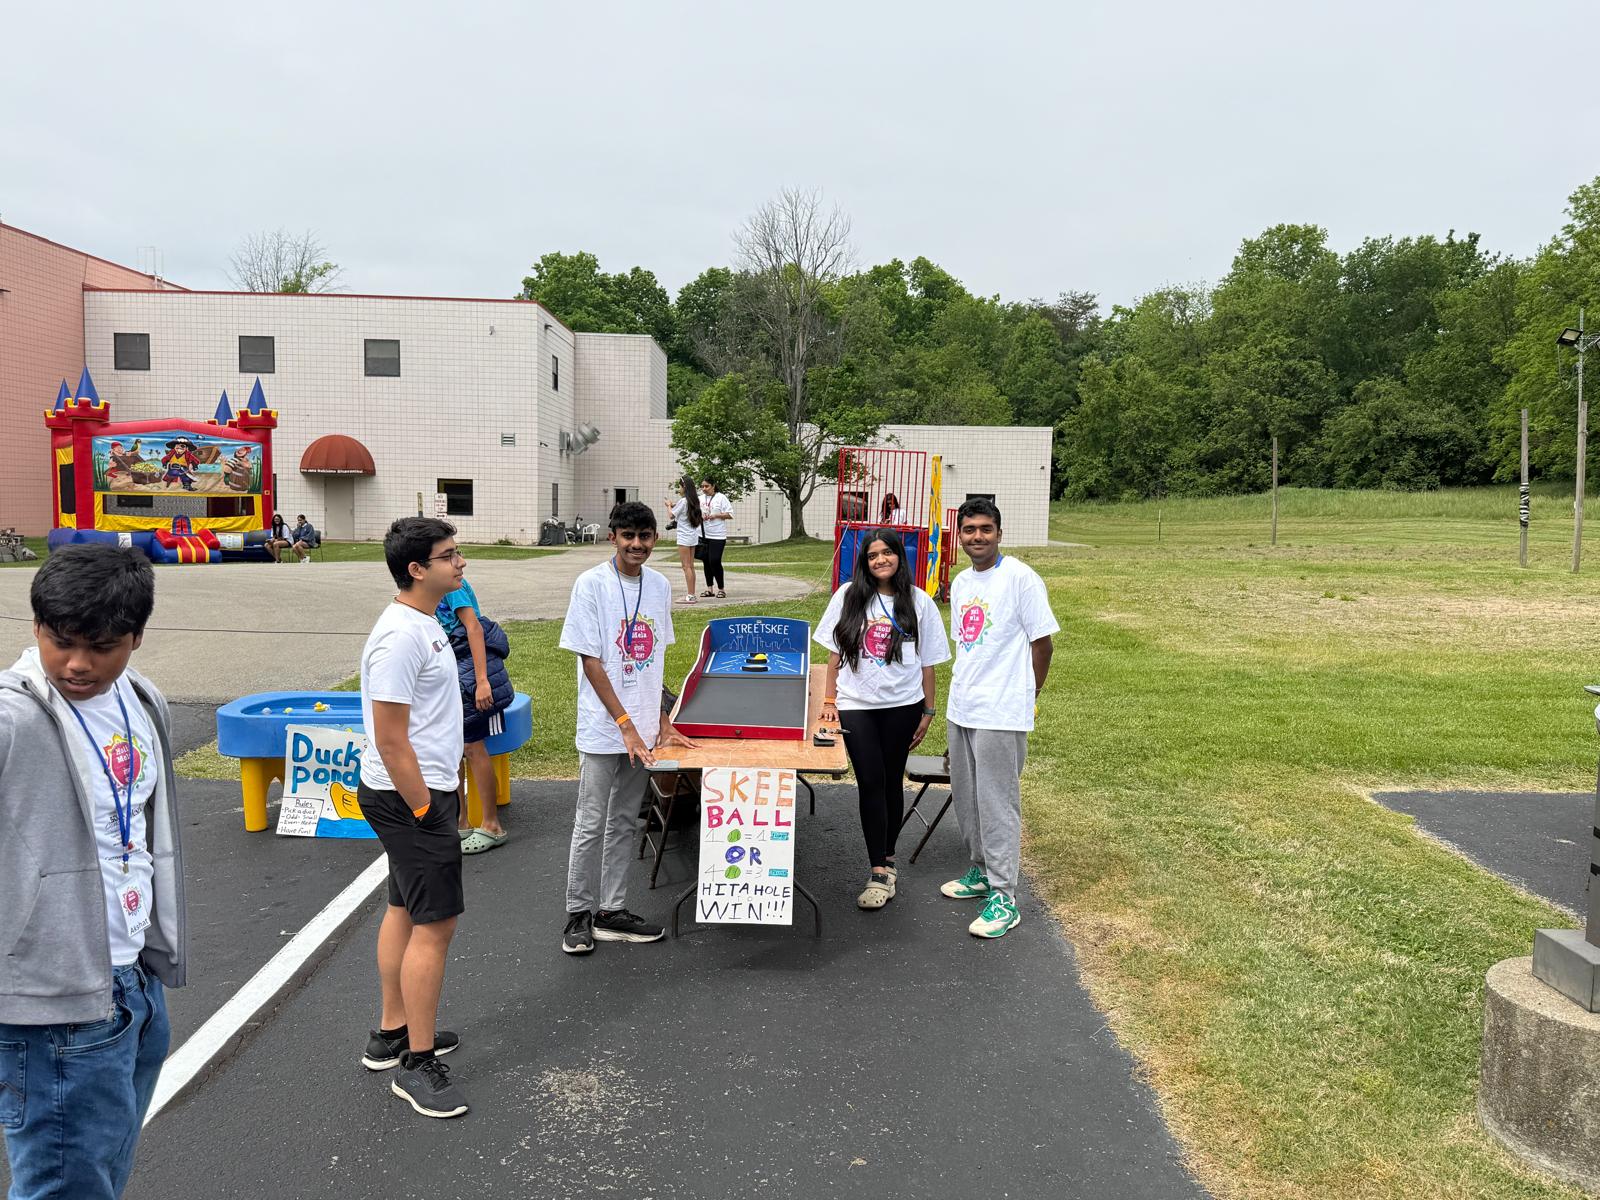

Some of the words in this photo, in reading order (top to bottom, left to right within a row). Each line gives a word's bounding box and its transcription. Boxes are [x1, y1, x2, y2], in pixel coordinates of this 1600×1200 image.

[292, 733, 361, 767] Duck
[702, 768, 794, 807] SKEE
[295, 799, 313, 808] Rules
[707, 805, 792, 829] BALL
[725, 845, 762, 867] OR
[755, 884, 791, 898] HOLE
